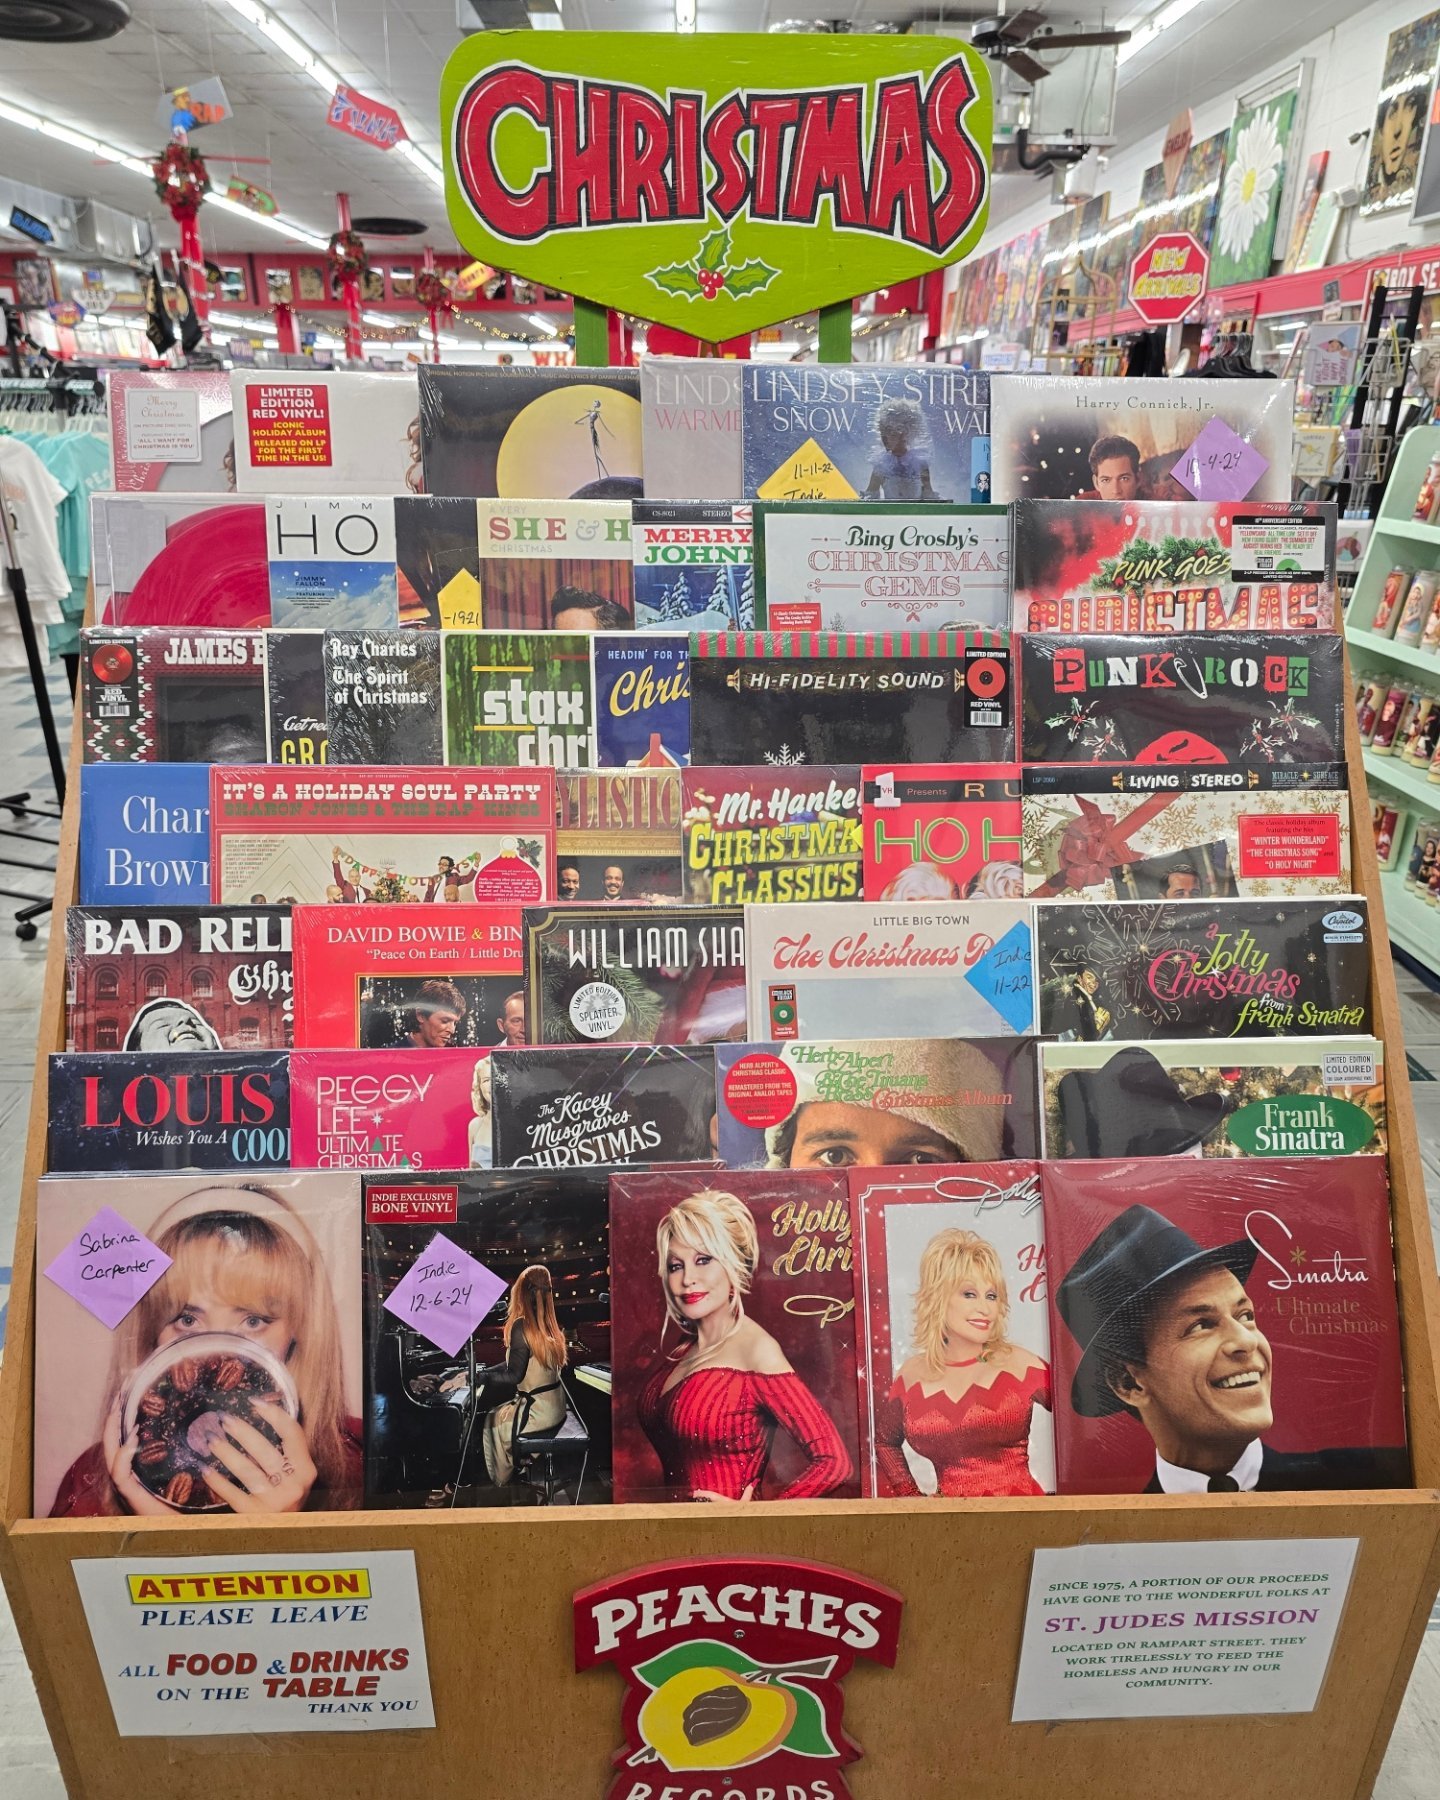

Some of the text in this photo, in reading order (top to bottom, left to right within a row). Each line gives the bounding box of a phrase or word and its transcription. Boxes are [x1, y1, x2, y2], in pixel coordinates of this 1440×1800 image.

[456, 60, 985, 255] CHRISTMAS
[1149, 246, 1192, 272] NEW
[1132, 272, 1202, 299] ARRIVALS
[261, 388, 313, 398] LIMITED
[753, 368, 990, 406] LINDSEY STIRL
[252, 408, 324, 418] RED VINYL!
[261, 398, 315, 408] EDITION
[273, 421, 304, 429] ICONIC
[773, 406, 990, 435] SNOW WAL
[253, 428, 326, 436] HOLIDAY ALBUM
[793, 462, 834, 480] 11-11-22
[783, 488, 827, 499] Indie
[489, 505, 527, 514] A VERY
[488, 516, 567, 541] SHE
[575, 518, 600, 542] &
[644, 528, 752, 543] MERRY
[845, 525, 979, 550] Bing Crosby's
[490, 544, 553, 553] CHRISTMAS
[807, 550, 1009, 572] CHRISTMAS
[1112, 558, 1166, 582] PUNK
[1172, 555, 1232, 581] GOES
[864, 575, 961, 597] GEMS
[164, 638, 248, 665] JAMES
[329, 638, 417, 660] Ray Charles
[749, 672, 945, 690] HI-FIDELITY SOUND
[1053, 648, 1309, 696] PUNK ROCK
[100, 694, 128, 702] VINYL
[334, 688, 428, 708] of Christmas
[483, 679, 584, 726] stax
[1129, 774, 1244, 788] LIVING STEREO
[1271, 771, 1299, 780] MIRACLE
[1312, 771, 1339, 780] SURFACE
[223, 782, 541, 800] IT'S A HOLIDAY SOUL PARTY
[873, 915, 970, 927] LITTLE BIG TOWN
[1327, 915, 1357, 926] Capitol
[84, 916, 292, 955] BAD RELI
[327, 925, 522, 943] DAVID BOWIE & BIN
[568, 926, 745, 970] WILLIAM SHA
[1193, 929, 1270, 976] Jolly
[1148, 949, 1301, 1002] Christmas
[1258, 993, 1285, 1011] from
[578, 1007, 618, 1023] SPLATTER
[732, 1069, 764, 1077] CHRISTMAS
[1326, 1065, 1372, 1074] COLOURED
[316, 1073, 434, 1105] PEGGY
[80, 1073, 275, 1128] LOUIS
[537, 1091, 614, 1125] The Kacey
[316, 1105, 368, 1136] LEE
[1263, 1100, 1335, 1129] Frank
[136, 1130, 183, 1146] Wishes
[187, 1129, 213, 1145] You
[215, 1129, 228, 1144] A
[526, 1110, 632, 1149] Musgraves
[1255, 1125, 1346, 1152] Sinatra
[371, 1193, 453, 1202] INDIE EXCLUSIVE
[371, 1201, 453, 1214] BONE VINYL
[79, 1232, 140, 1258] Sabrina
[1244, 1209, 1369, 1290] Sinatra
[81, 1258, 156, 1281] Carpenter
[416, 1260, 461, 1285] Indie
[410, 1284, 474, 1313] 12-6-24
[1276, 1297, 1360, 1316] Ultimate
[1288, 1316, 1389, 1336] Christmas
[137, 1573, 360, 1598] ATTENTION
[1048, 1573, 1329, 1592] SINCE 1975, A PORTION OF OUR PROCEEDS
[1042, 1587, 1330, 1605] HAVE GONE TO THE WONDERFUL FOLKS AT
[140, 1604, 369, 1626] PLEASE LEAVE
[591, 1583, 882, 1655] PEACHES
[1044, 1608, 1320, 1634] ST. JUDES MISSION
[1051, 1636, 1307, 1652] LOCATED ON RAMPART STREET. THEY
[118, 1647, 410, 1677] ALL FOOD & DRINKS
[1066, 1650, 1284, 1665] WORK TIRELESSLY TO FEED THE
[1063, 1663, 1281, 1678] HOMELESS AND HUNGRY IN OUR
[156, 1676, 380, 1701] ON THE TABLE
[1125, 1678, 1213, 1689] COMMUNITY.
[307, 1700, 419, 1714] THANK YOU
[625, 1780, 835, 1800] RECORDS
